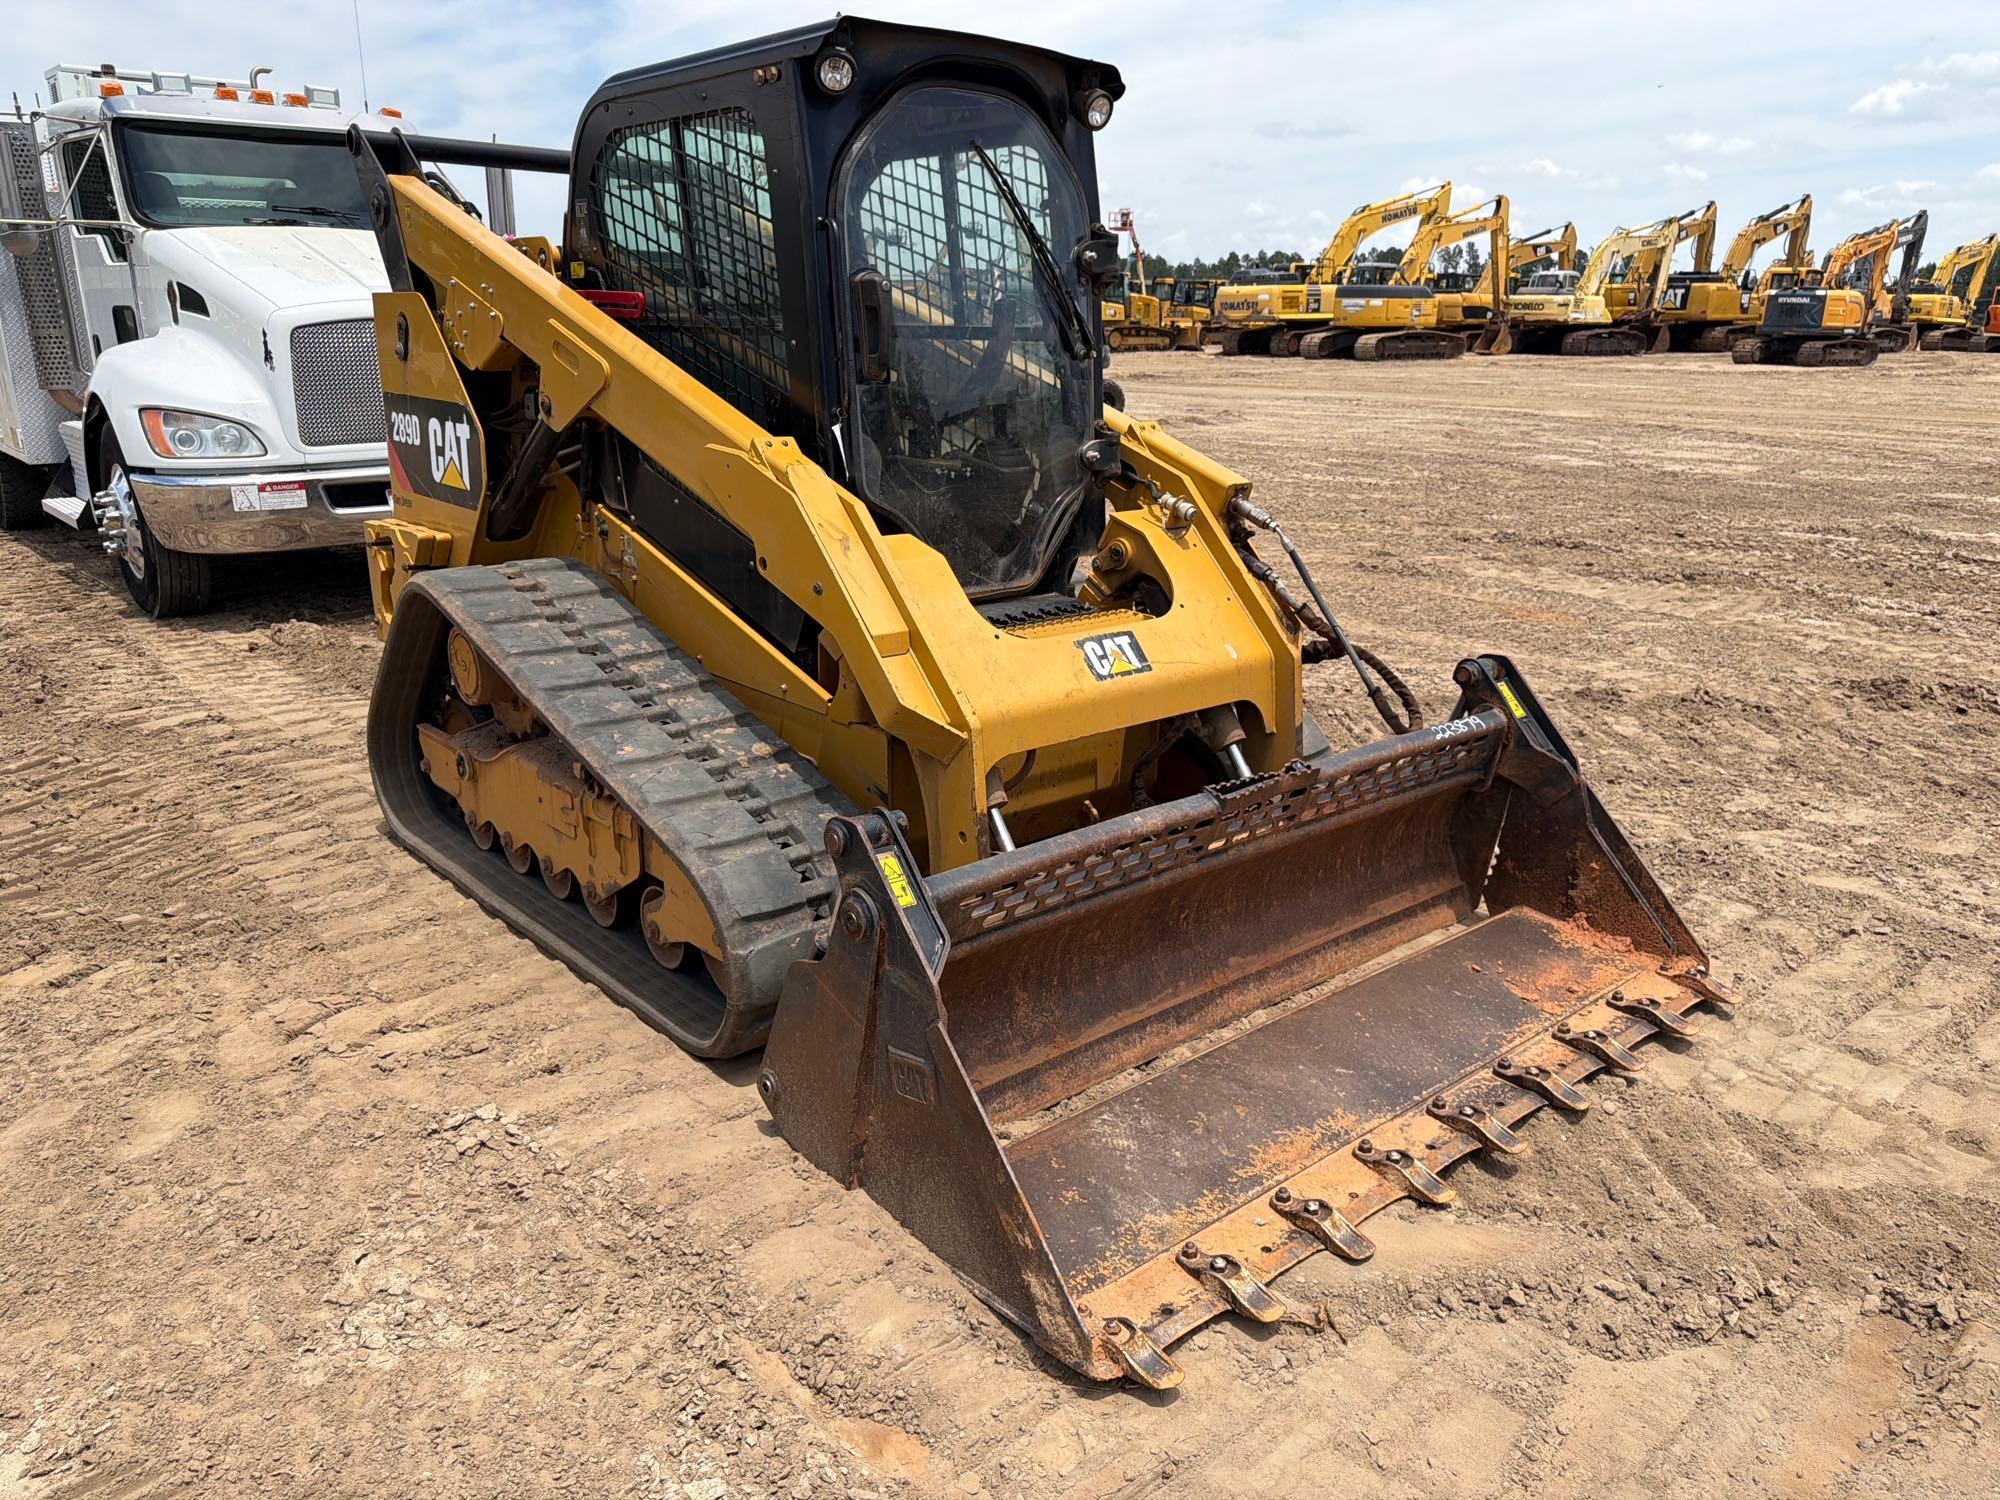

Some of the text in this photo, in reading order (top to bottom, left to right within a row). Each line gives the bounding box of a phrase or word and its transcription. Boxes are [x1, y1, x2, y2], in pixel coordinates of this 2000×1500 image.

[1381, 206, 1418, 223] KOMATSU
[1513, 302, 1545, 311] KOBELCO
[1777, 296, 1810, 304] HYUNDAI
[391, 411, 421, 446] 289D
[428, 415, 471, 491] CAT
[1083, 635, 1142, 676] CAT
[1431, 715, 1486, 740] 223879
